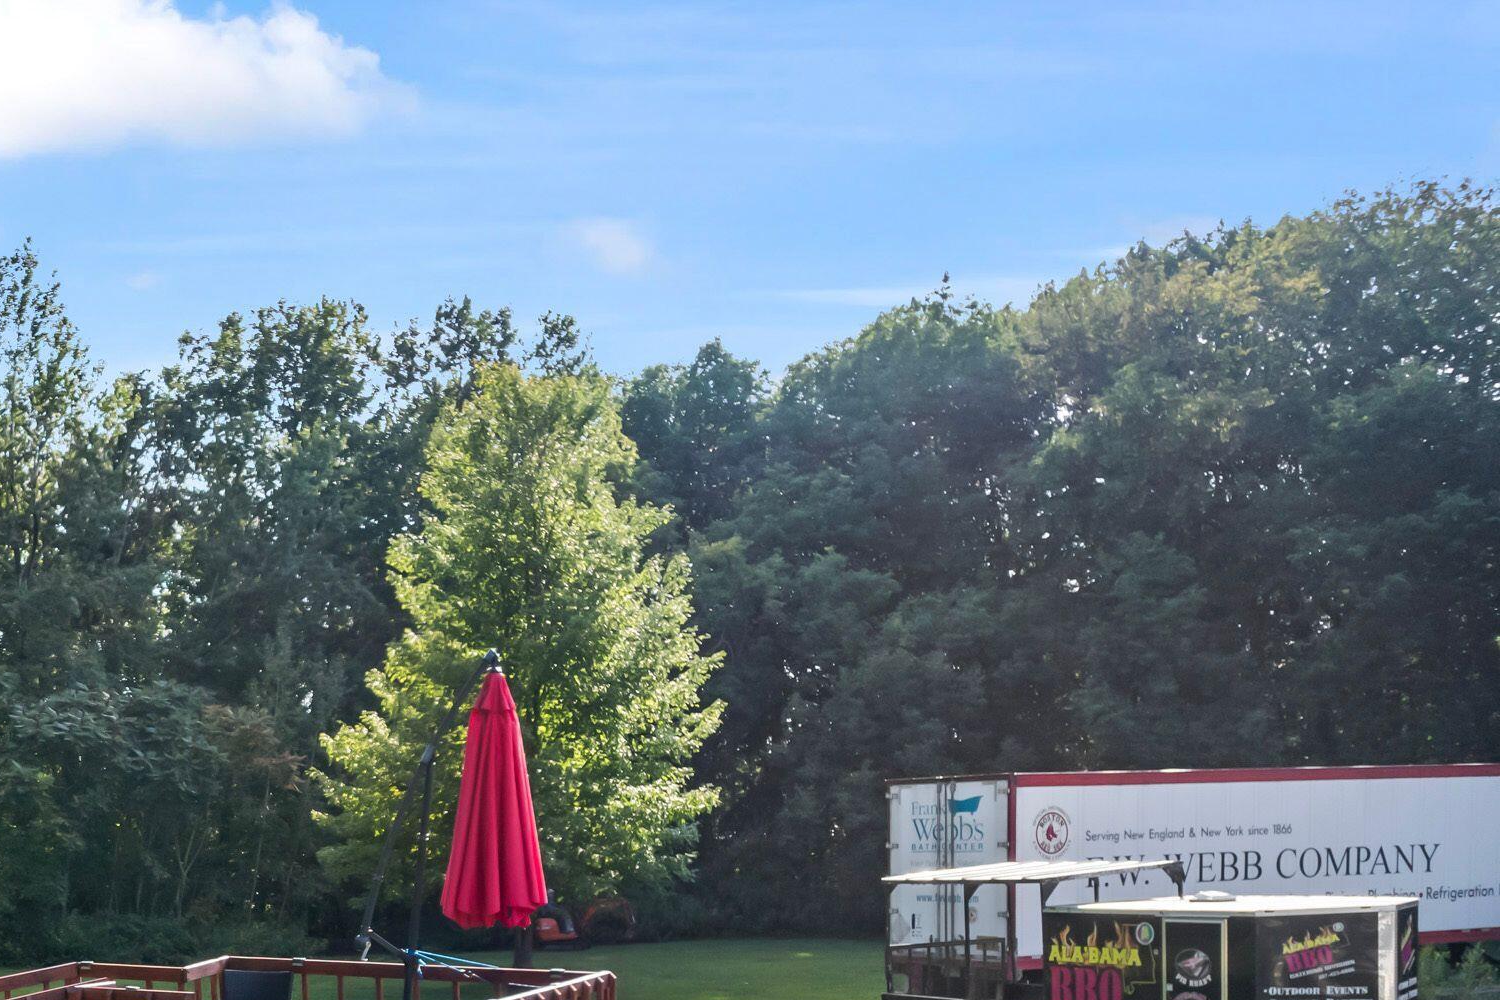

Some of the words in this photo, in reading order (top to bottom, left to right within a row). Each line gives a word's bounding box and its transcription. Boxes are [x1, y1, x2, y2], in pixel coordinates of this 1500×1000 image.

[1085, 830, 1120, 843] Serving
[1123, 828, 1145, 840] New
[1149, 827, 1185, 841] England
[1189, 827, 1196, 838] &
[1200, 827, 1221, 838] New
[1225, 825, 1243, 836] York
[1248, 824, 1269, 836] since
[1273, 824, 1293, 835] 1866
[1276, 843, 1440, 880] COMPANY
[1426, 886, 1495, 902] Refrigeration
[1284, 944, 1333, 973] BBQ
